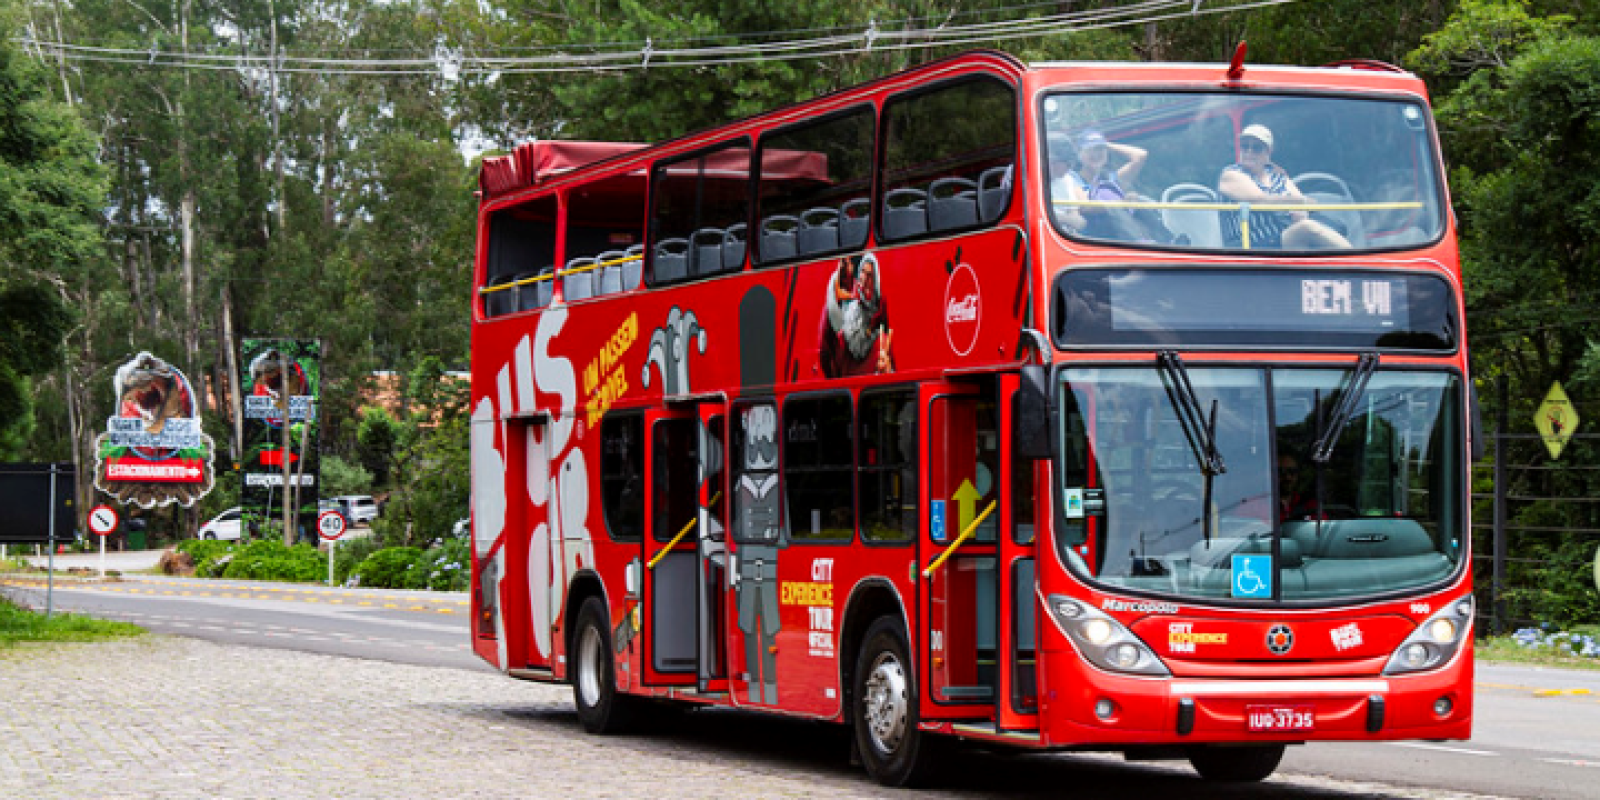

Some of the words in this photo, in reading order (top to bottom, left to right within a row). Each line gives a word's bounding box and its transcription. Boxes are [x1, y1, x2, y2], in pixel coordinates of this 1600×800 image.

[1301, 279, 1351, 314] BEM
[322, 517, 341, 530] 40
[811, 558, 834, 581] CITY
[781, 581, 834, 606] EXPERIENCE
[1102, 597, 1179, 614] Marcopolo
[1168, 622, 1193, 634] CITY
[1168, 643, 1196, 654] TOUR
